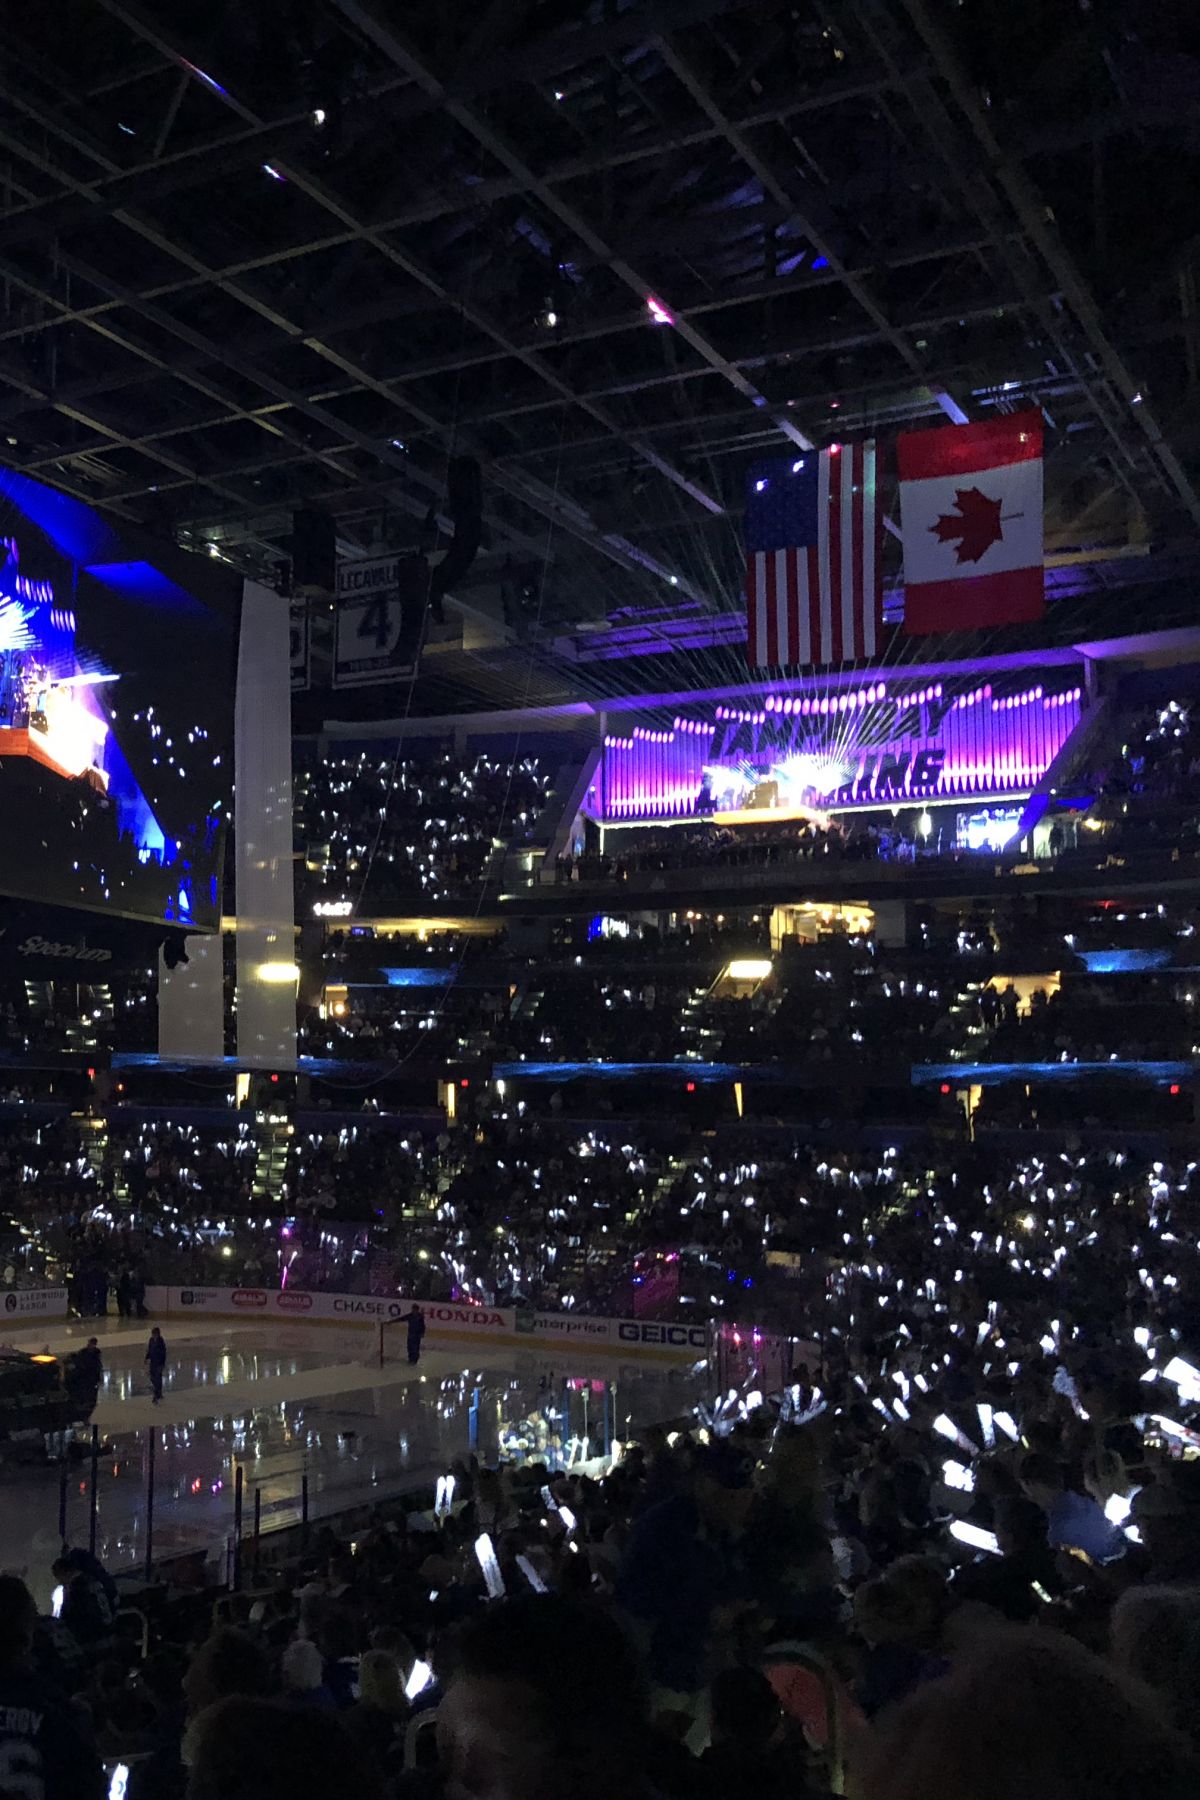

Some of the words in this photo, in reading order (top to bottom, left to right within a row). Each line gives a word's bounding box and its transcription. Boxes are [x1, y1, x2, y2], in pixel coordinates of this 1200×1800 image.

[357, 597, 392, 650] 4
[17, 935, 112, 962] Spectrum
[334, 1299, 385, 1315] CHASE
[421, 1306, 505, 1327] HONDA
[618, 1323, 707, 1348] GEICO
